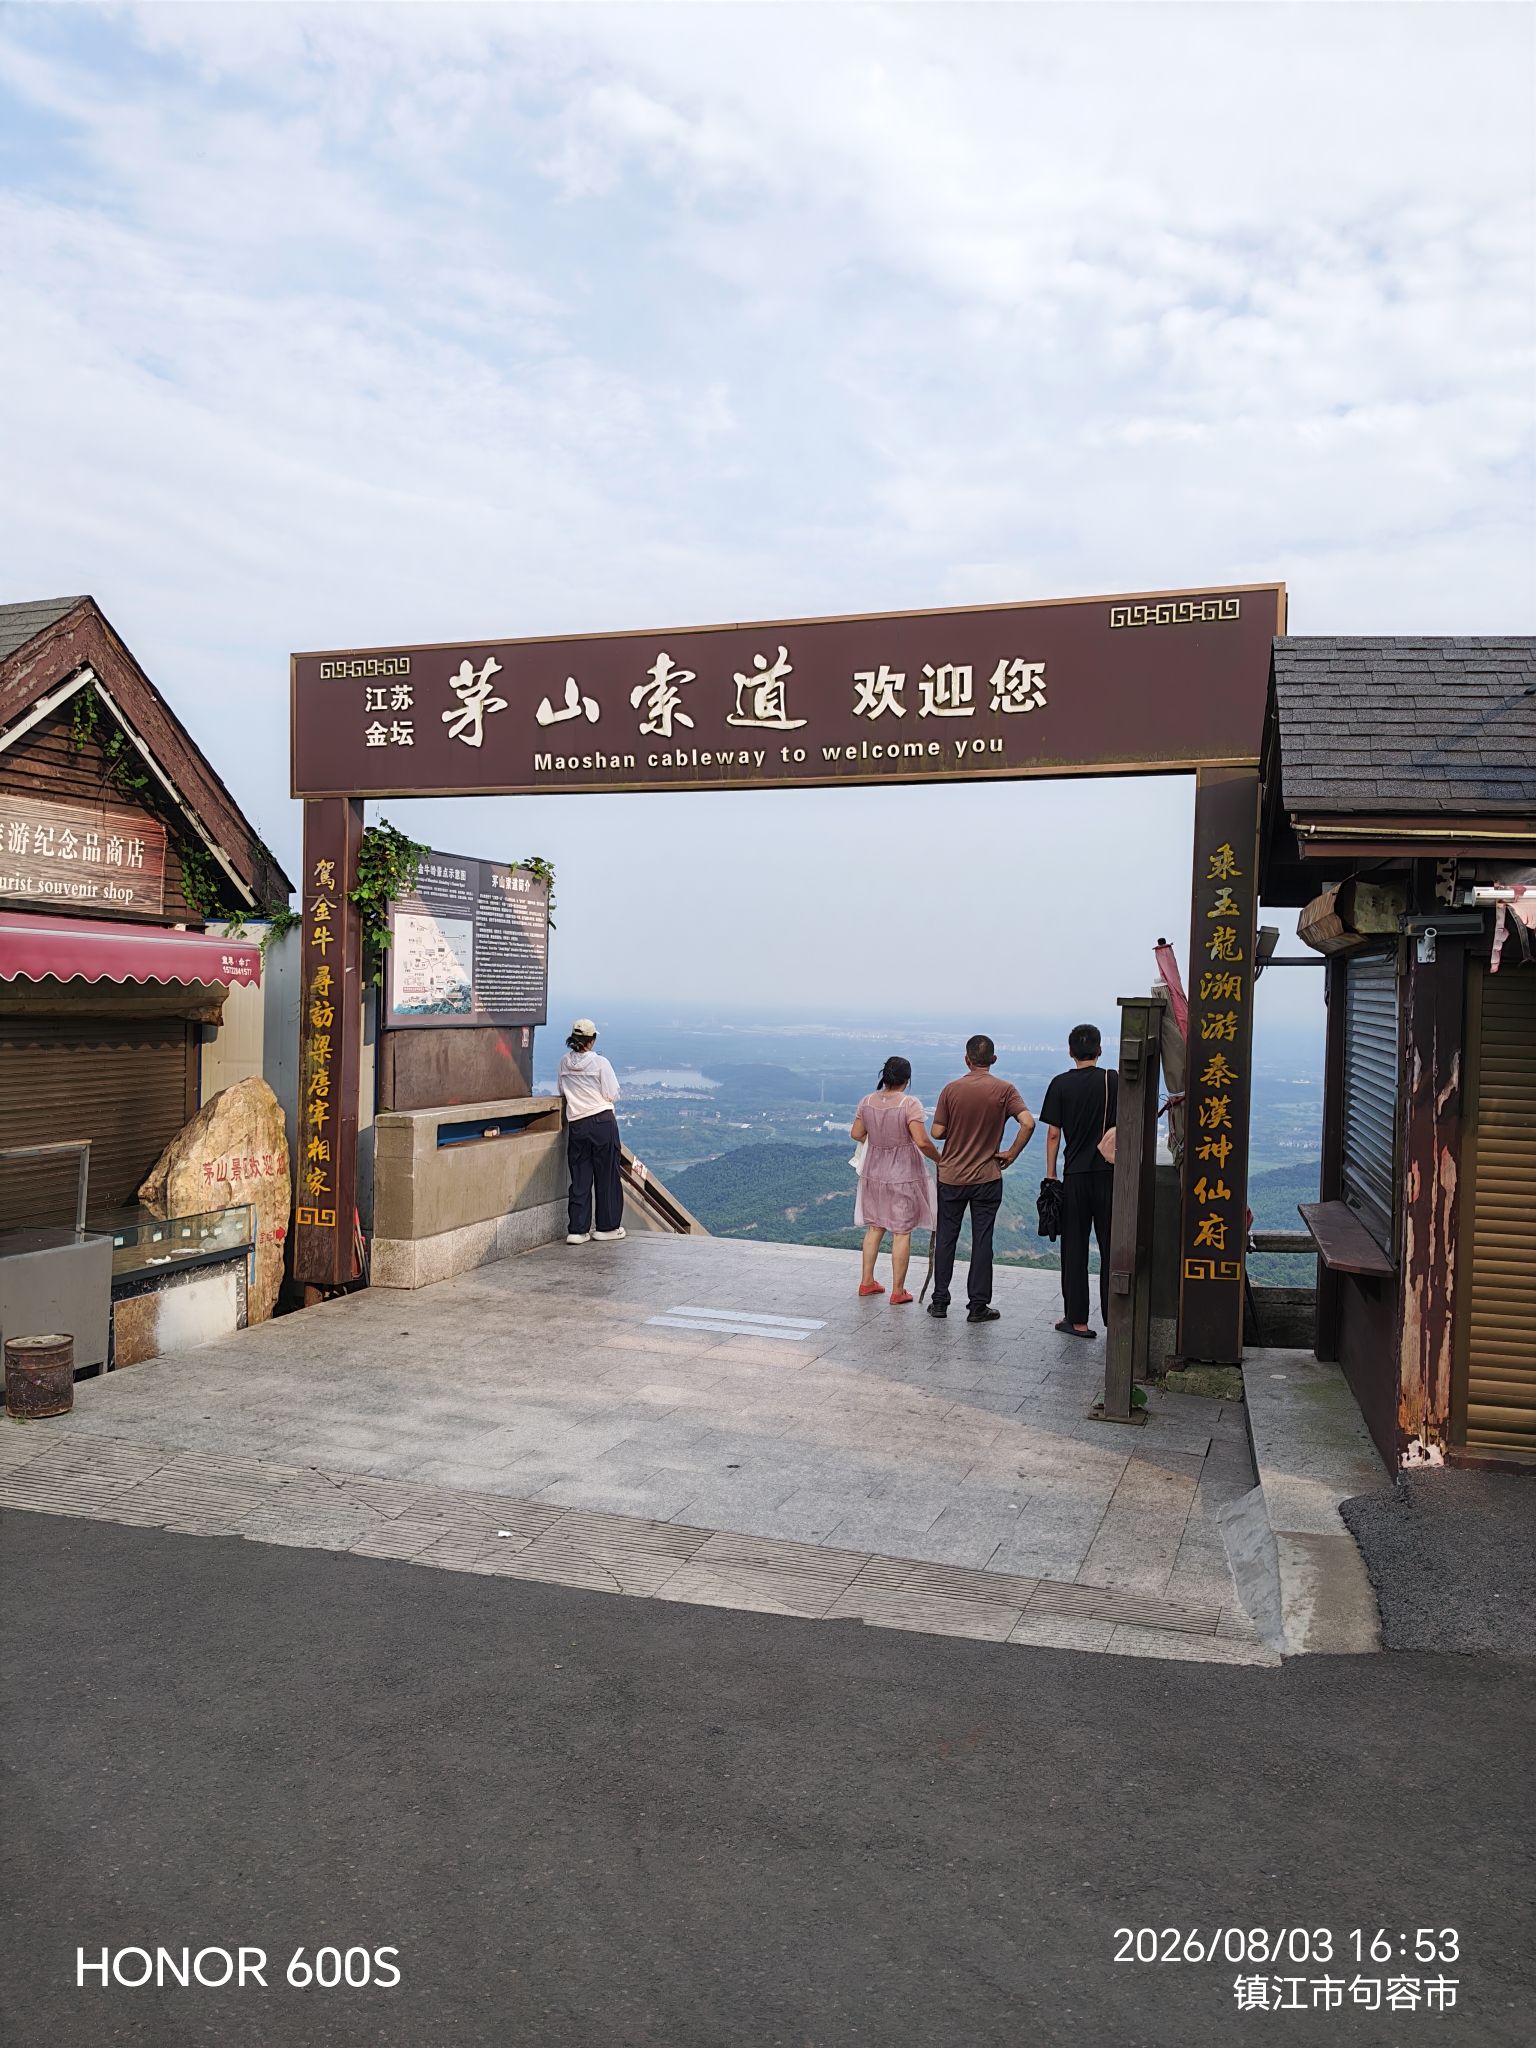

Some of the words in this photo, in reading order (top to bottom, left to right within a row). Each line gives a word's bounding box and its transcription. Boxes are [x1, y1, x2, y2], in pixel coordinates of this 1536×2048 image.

[364, 685, 415, 713] 江苏
[441, 645, 809, 748] 茅山索道
[852, 658, 1047, 720] 欢迎您
[364, 720, 415, 748] 金坛
[534, 751, 636, 772] Maoshan
[647, 747, 766, 769] cableway
[780, 746, 806, 763] to
[822, 741, 941, 761] welcome
[955, 737, 1004, 757] you
[0, 822, 145, 869] 游纪念品商店
[38, 879, 98, 898] souvenir
[103, 883, 134, 905] shop
